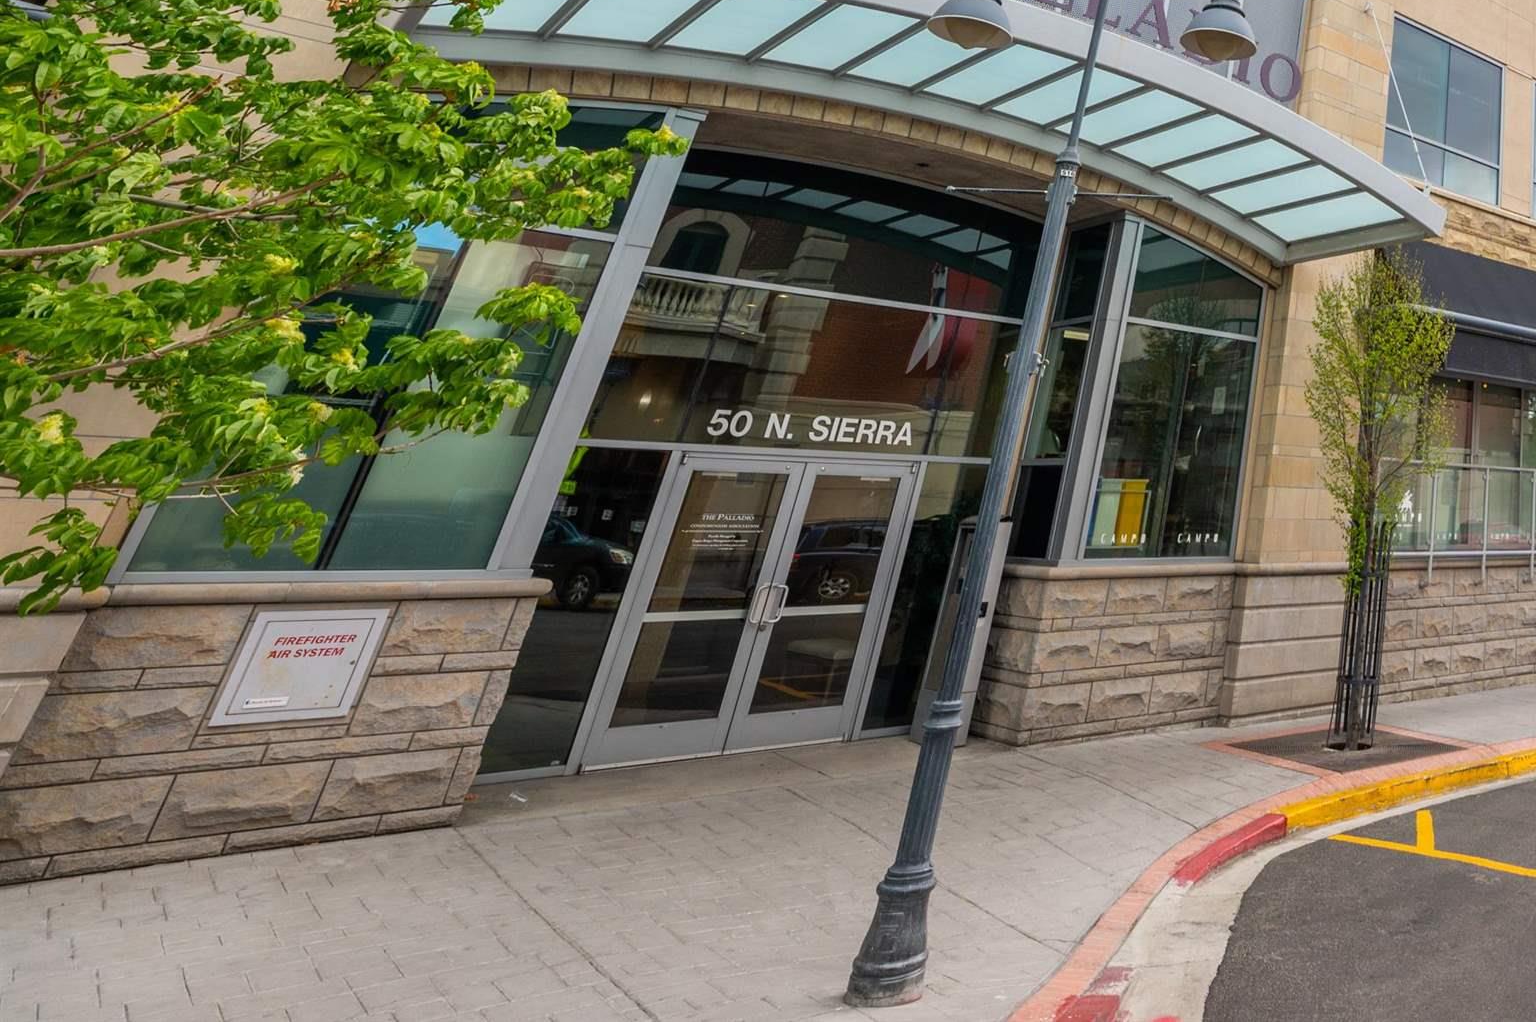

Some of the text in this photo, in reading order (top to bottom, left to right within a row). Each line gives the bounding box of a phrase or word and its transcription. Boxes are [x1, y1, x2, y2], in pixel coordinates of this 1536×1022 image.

[706, 409, 913, 446] 50 N. SIERRA
[1100, 533, 1147, 544] CAMPO
[1177, 533, 1219, 544] CAMPO
[274, 634, 358, 647] FIREFIGHTER
[267, 647, 345, 659] AIR SYSTEM
